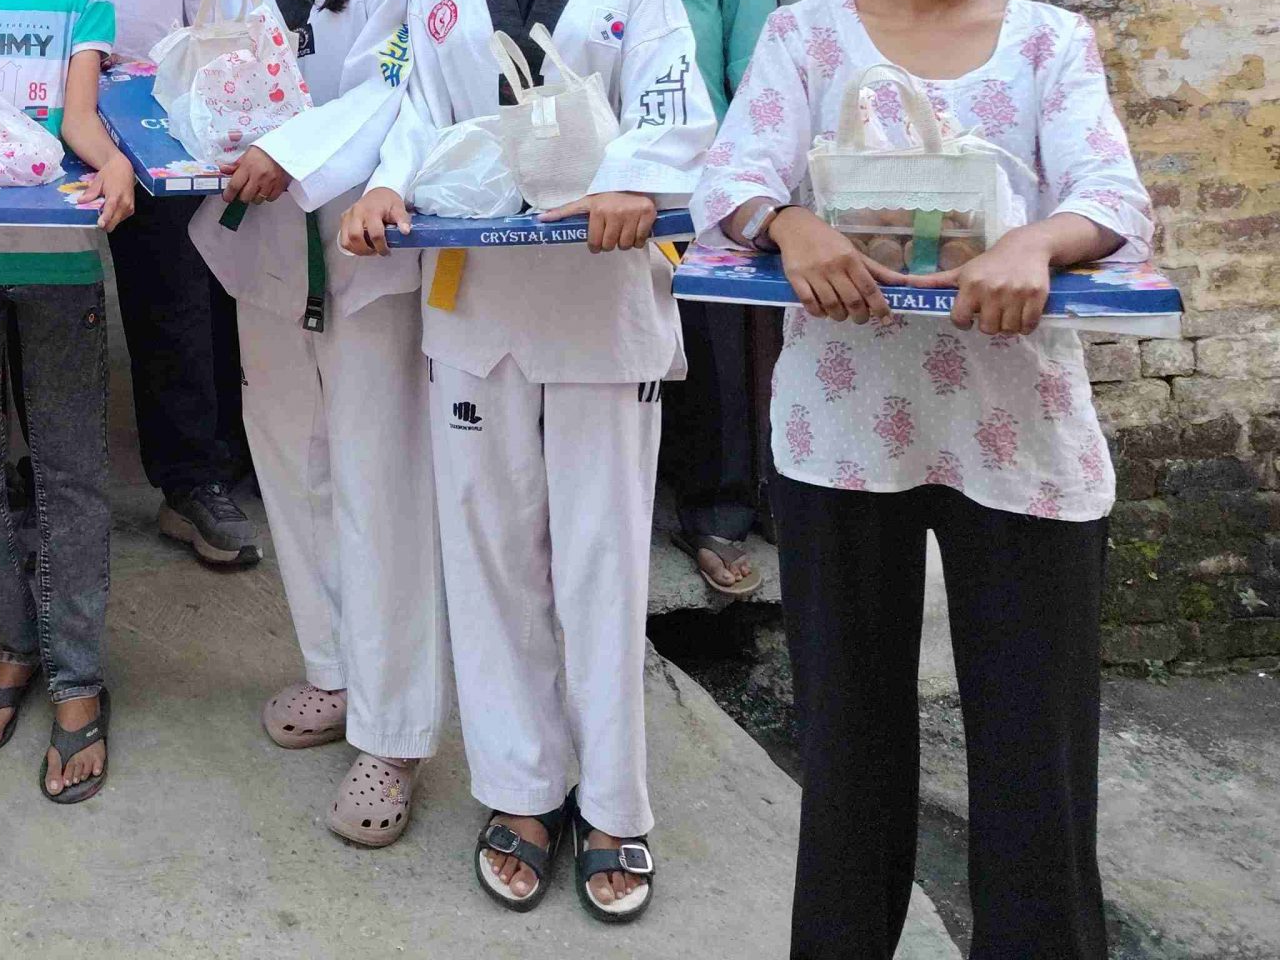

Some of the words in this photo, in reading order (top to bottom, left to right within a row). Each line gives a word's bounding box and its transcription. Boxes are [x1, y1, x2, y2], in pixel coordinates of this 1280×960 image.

[28, 82, 48, 101] 85
[480, 229, 548, 243] CRYSTAL
[551, 228, 588, 241] KING
[883, 293, 930, 309] STAL
[935, 295, 955, 310] KI
